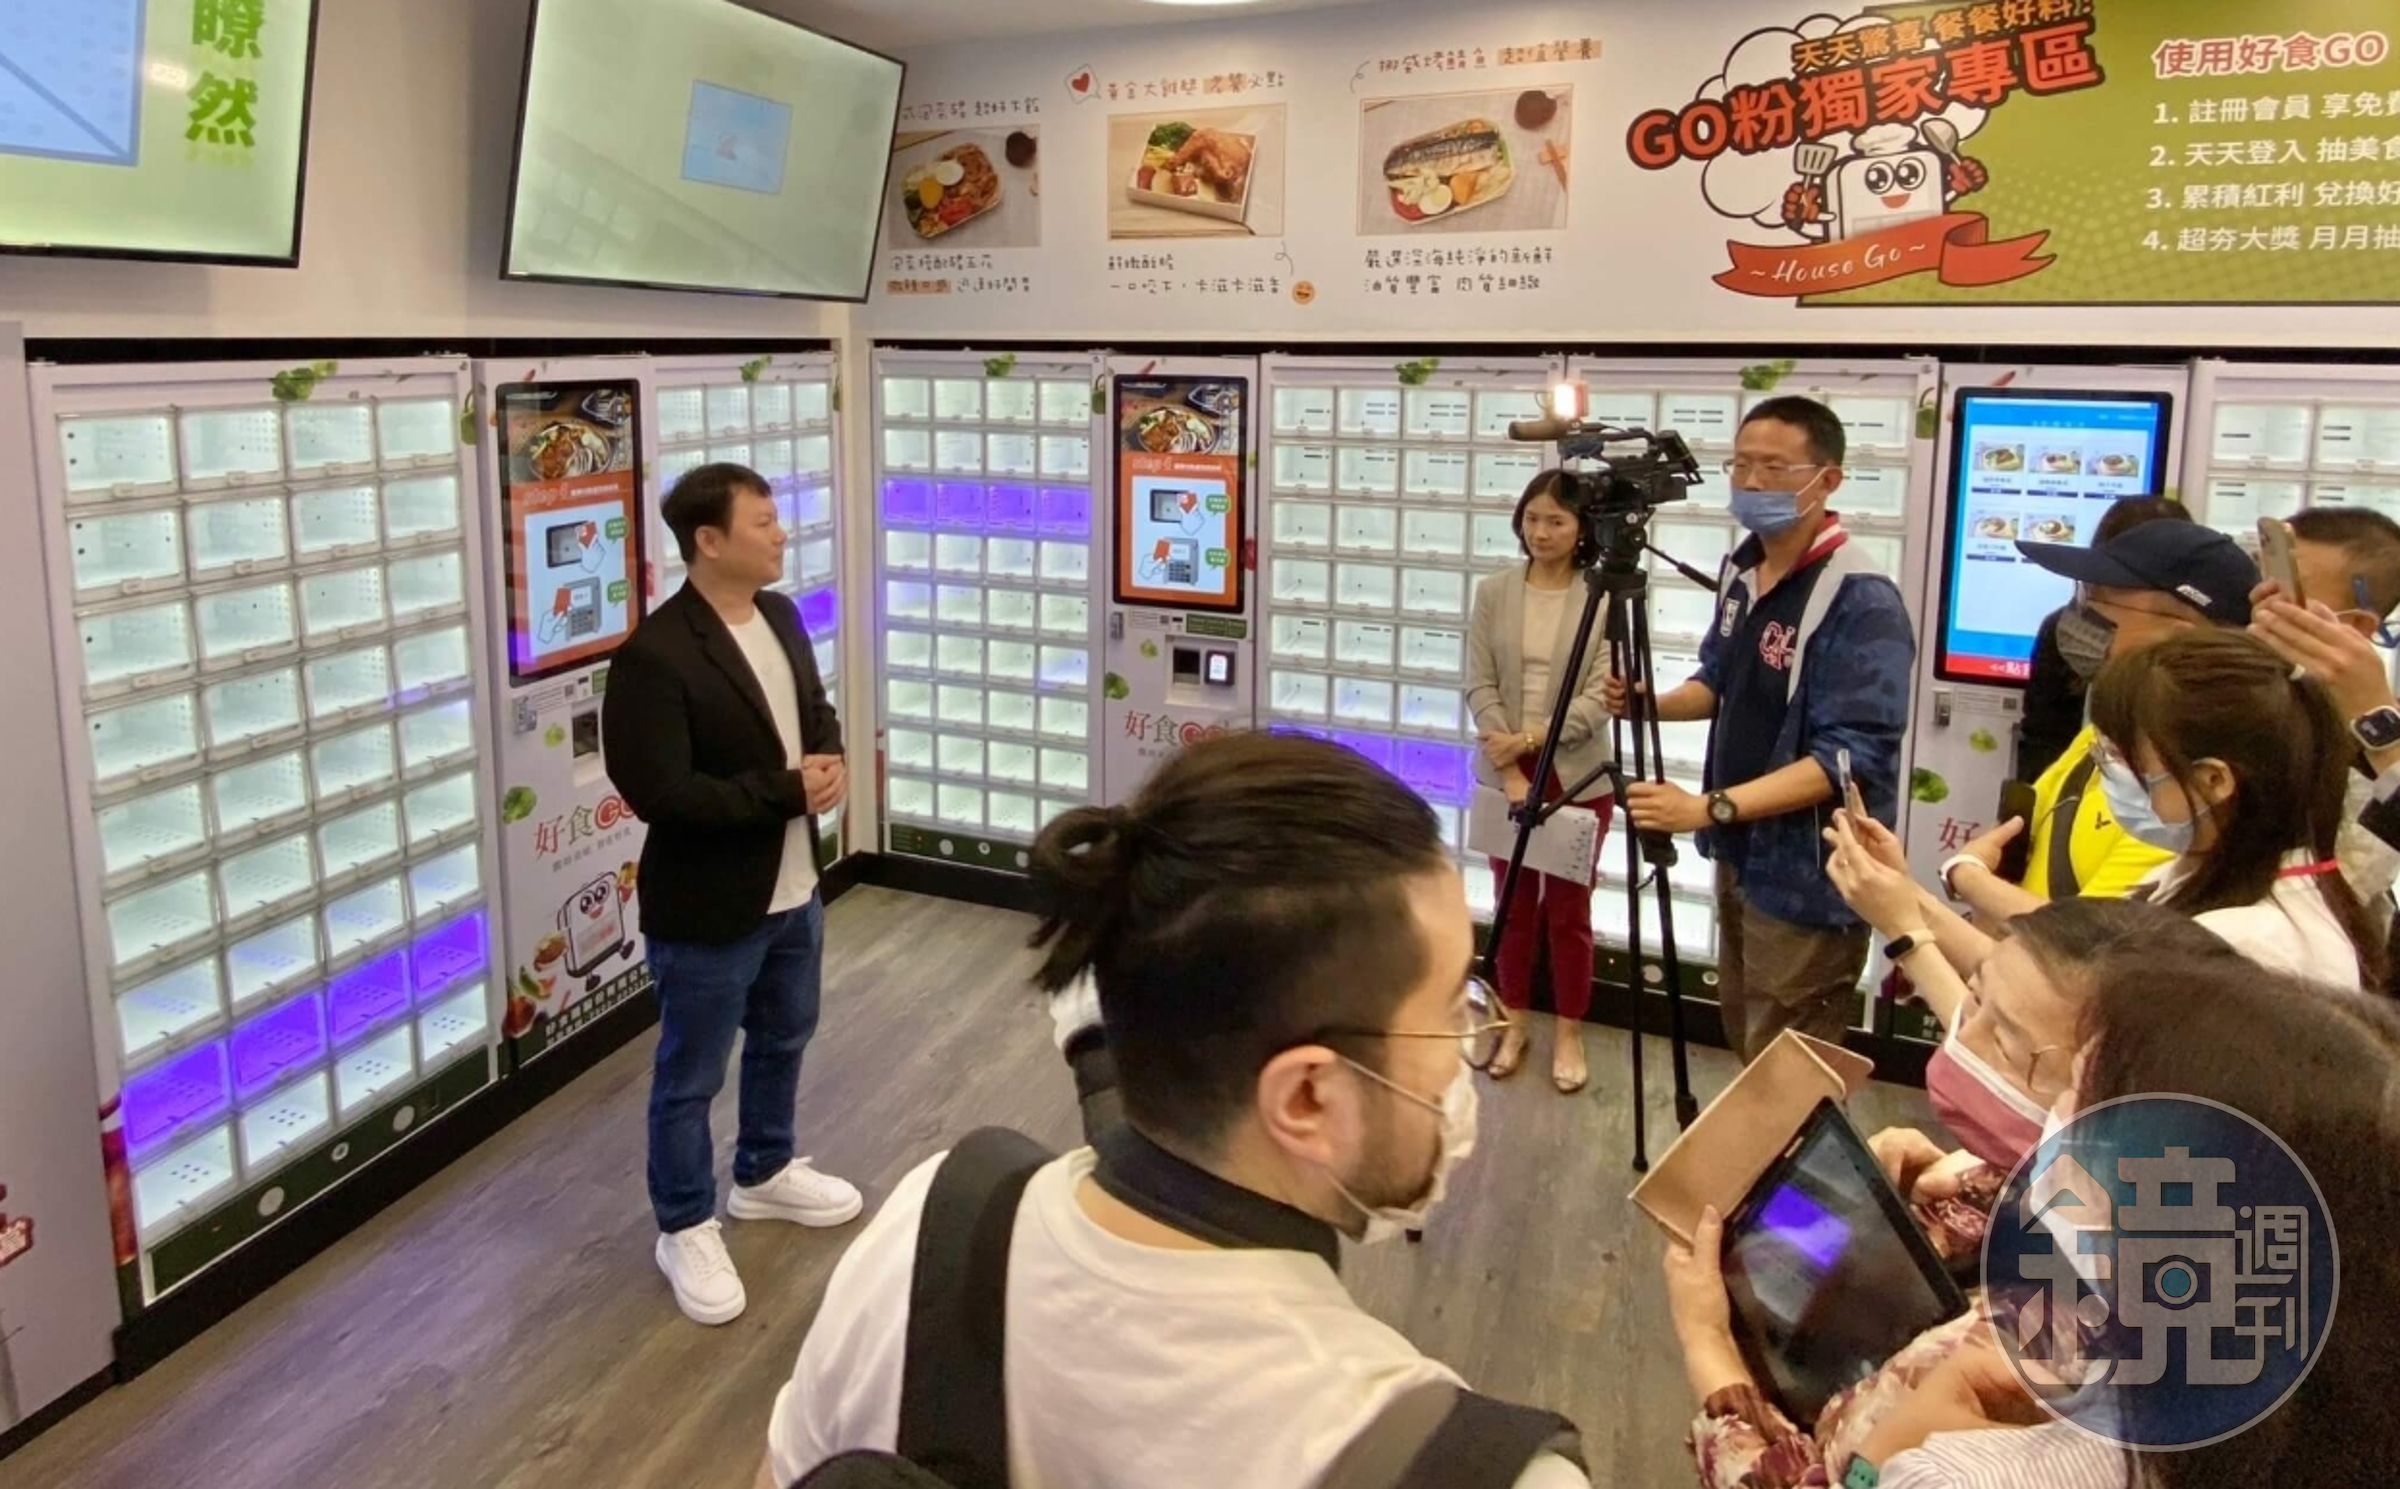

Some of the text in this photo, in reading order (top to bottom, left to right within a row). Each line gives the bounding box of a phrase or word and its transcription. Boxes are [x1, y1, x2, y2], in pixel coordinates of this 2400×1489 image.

[1794, 19, 1924, 71] 天天驚喜
[2154, 32, 2387, 77] 使用好食GO
[1632, 21, 2098, 166] GO粉獨家專區
[2153, 103, 2179, 124] 1.
[2188, 94, 2311, 124] 註冊會員
[2149, 145, 2175, 166] 2.
[2184, 139, 2307, 166] 天天登入
[2145, 188, 2171, 209] 3.
[2181, 182, 2304, 209] 累積紅利
[2142, 230, 2168, 250] 4.
[2177, 225, 2300, 251] 超夯大獎
[1772, 244, 1901, 284] House Go
